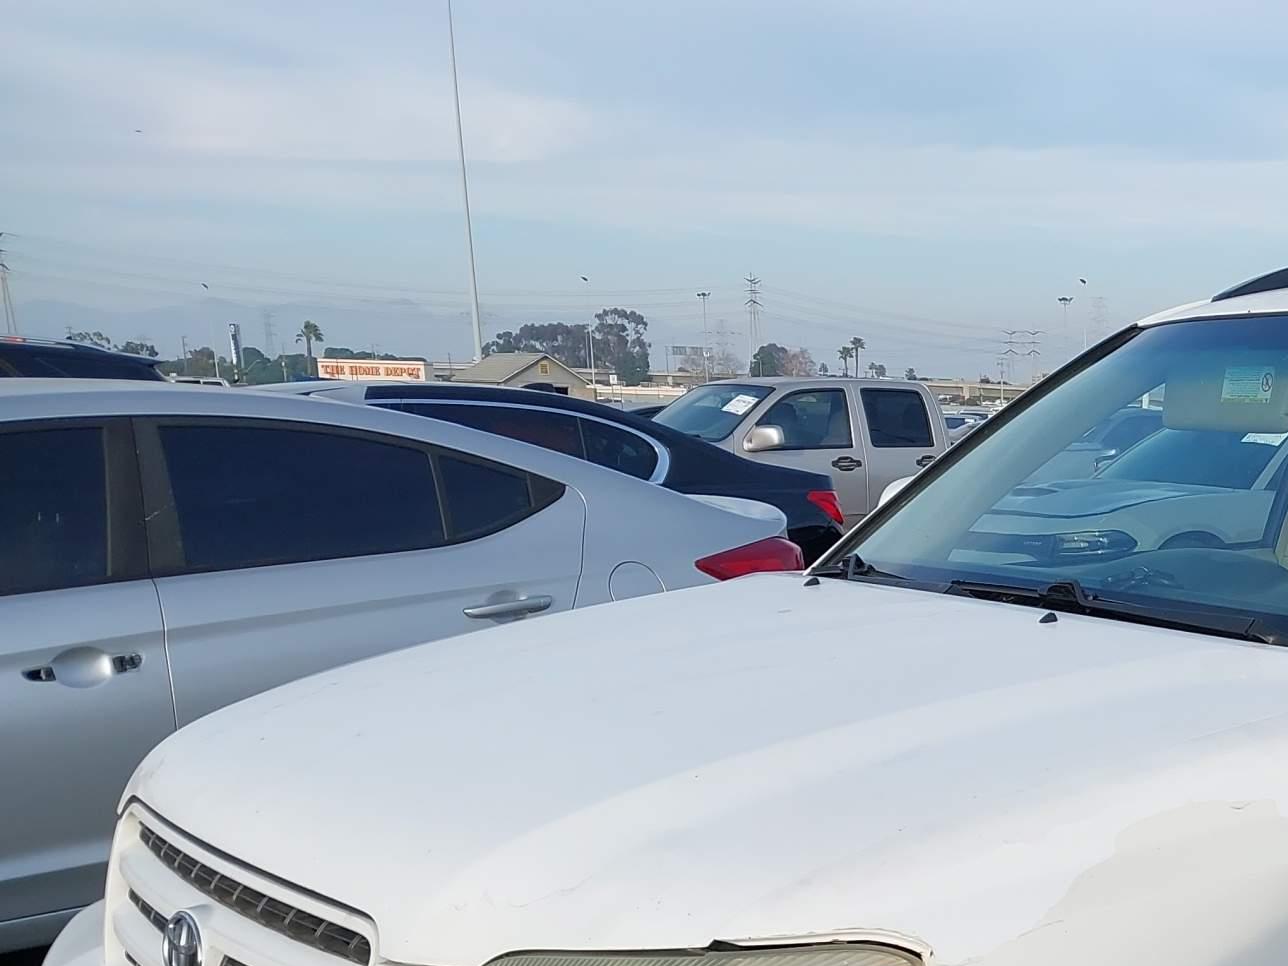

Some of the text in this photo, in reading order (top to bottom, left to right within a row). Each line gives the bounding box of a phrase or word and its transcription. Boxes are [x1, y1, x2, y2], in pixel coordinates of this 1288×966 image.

[321, 364, 421, 379] THE HOME DEPOT
